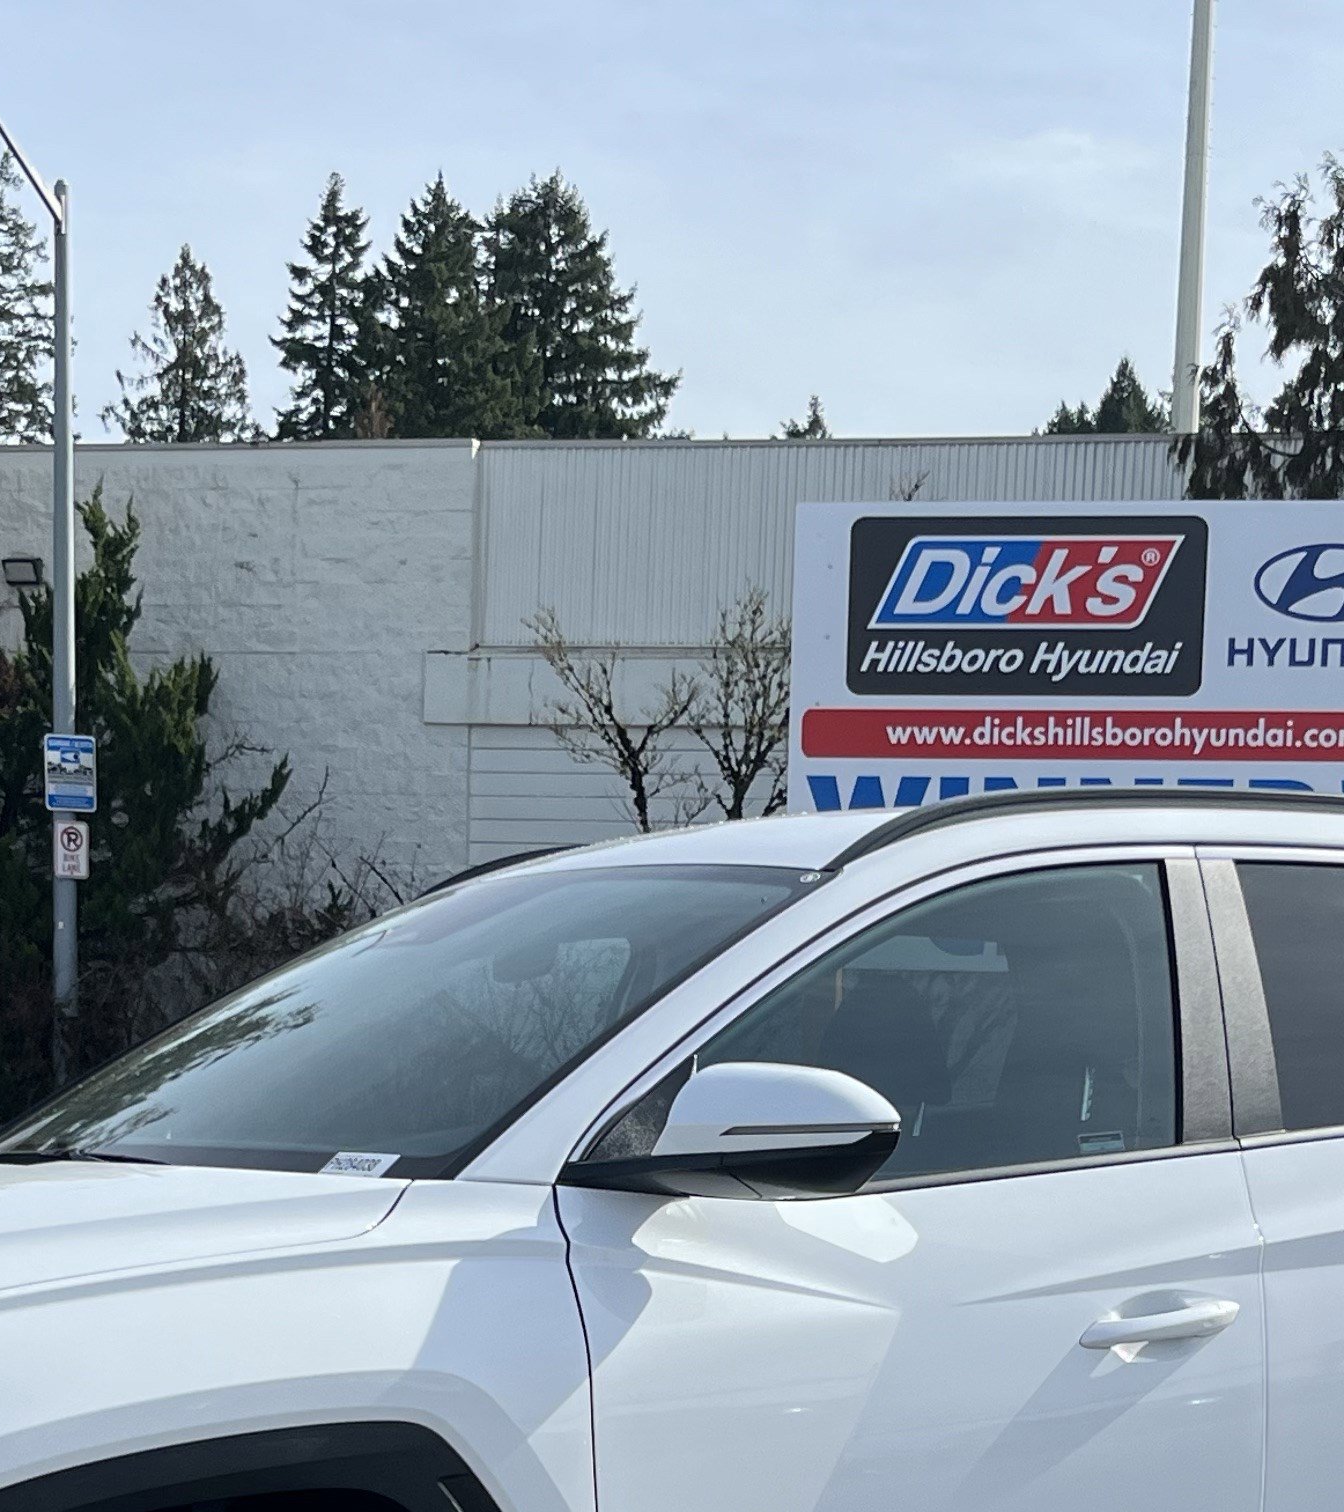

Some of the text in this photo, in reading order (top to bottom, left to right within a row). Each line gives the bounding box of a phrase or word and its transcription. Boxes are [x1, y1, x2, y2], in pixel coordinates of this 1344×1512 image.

[893, 545, 1145, 617] Dick's
[860, 641, 1184, 682] Hillsboro Hyundai
